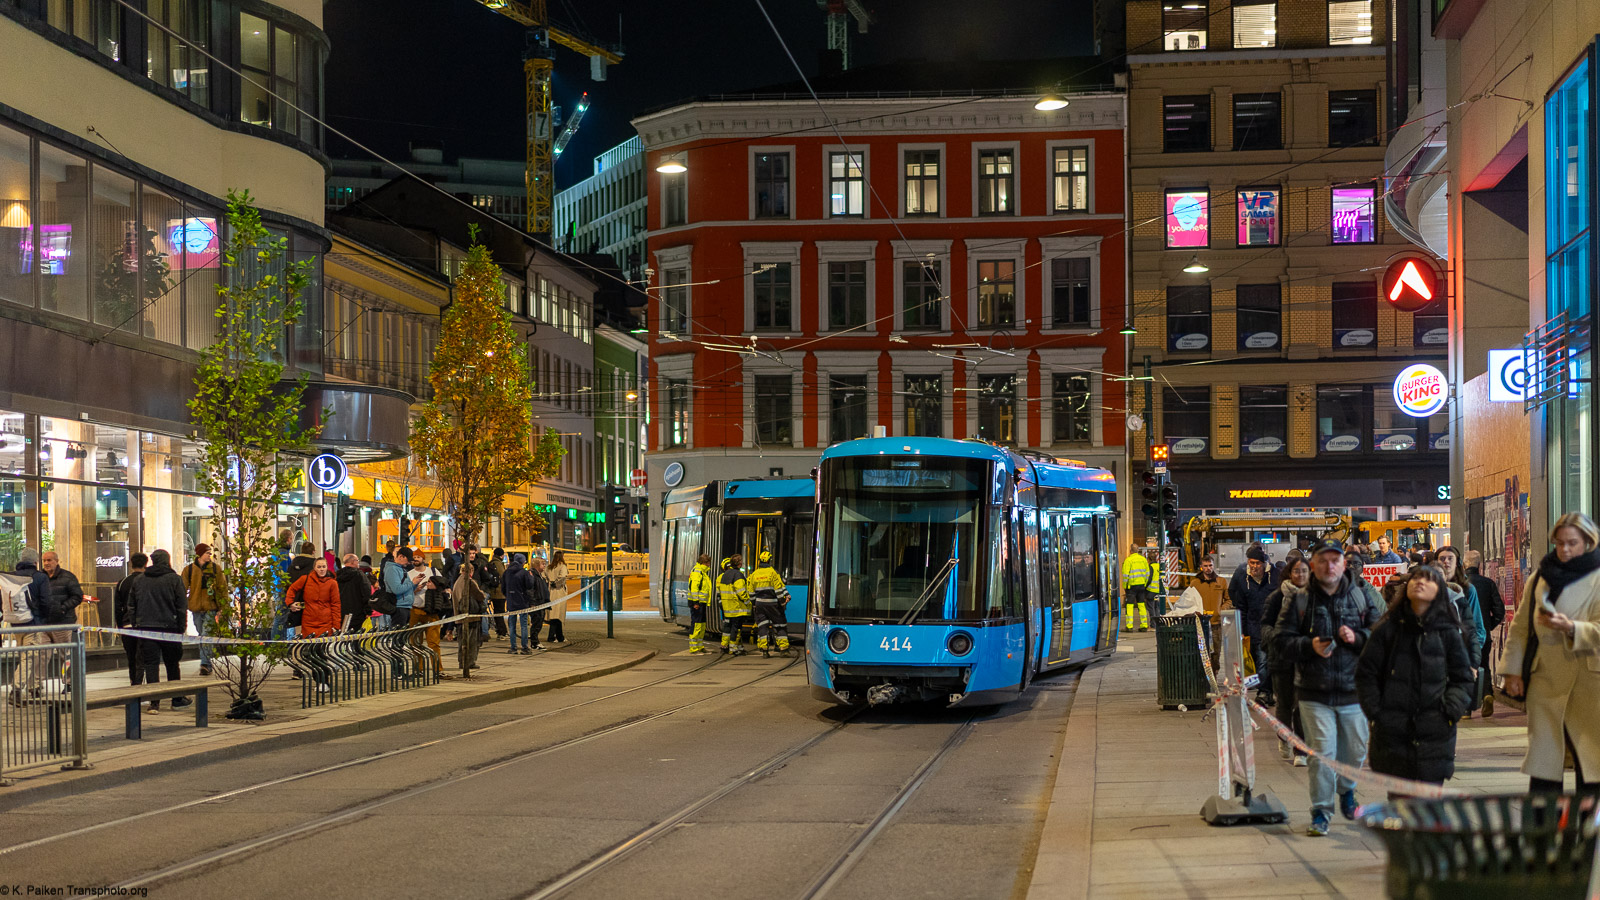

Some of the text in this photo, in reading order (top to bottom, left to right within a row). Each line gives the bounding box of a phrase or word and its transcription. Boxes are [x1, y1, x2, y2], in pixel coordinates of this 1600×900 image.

[1241, 192, 1274, 210] VR
[1402, 375, 1439, 391] BURGER
[1404, 384, 1440, 403] KING
[1229, 489, 1312, 499] PLATEKOMPANIET
[1363, 567, 1397, 576] KONGE
[880, 636, 912, 651] 414
